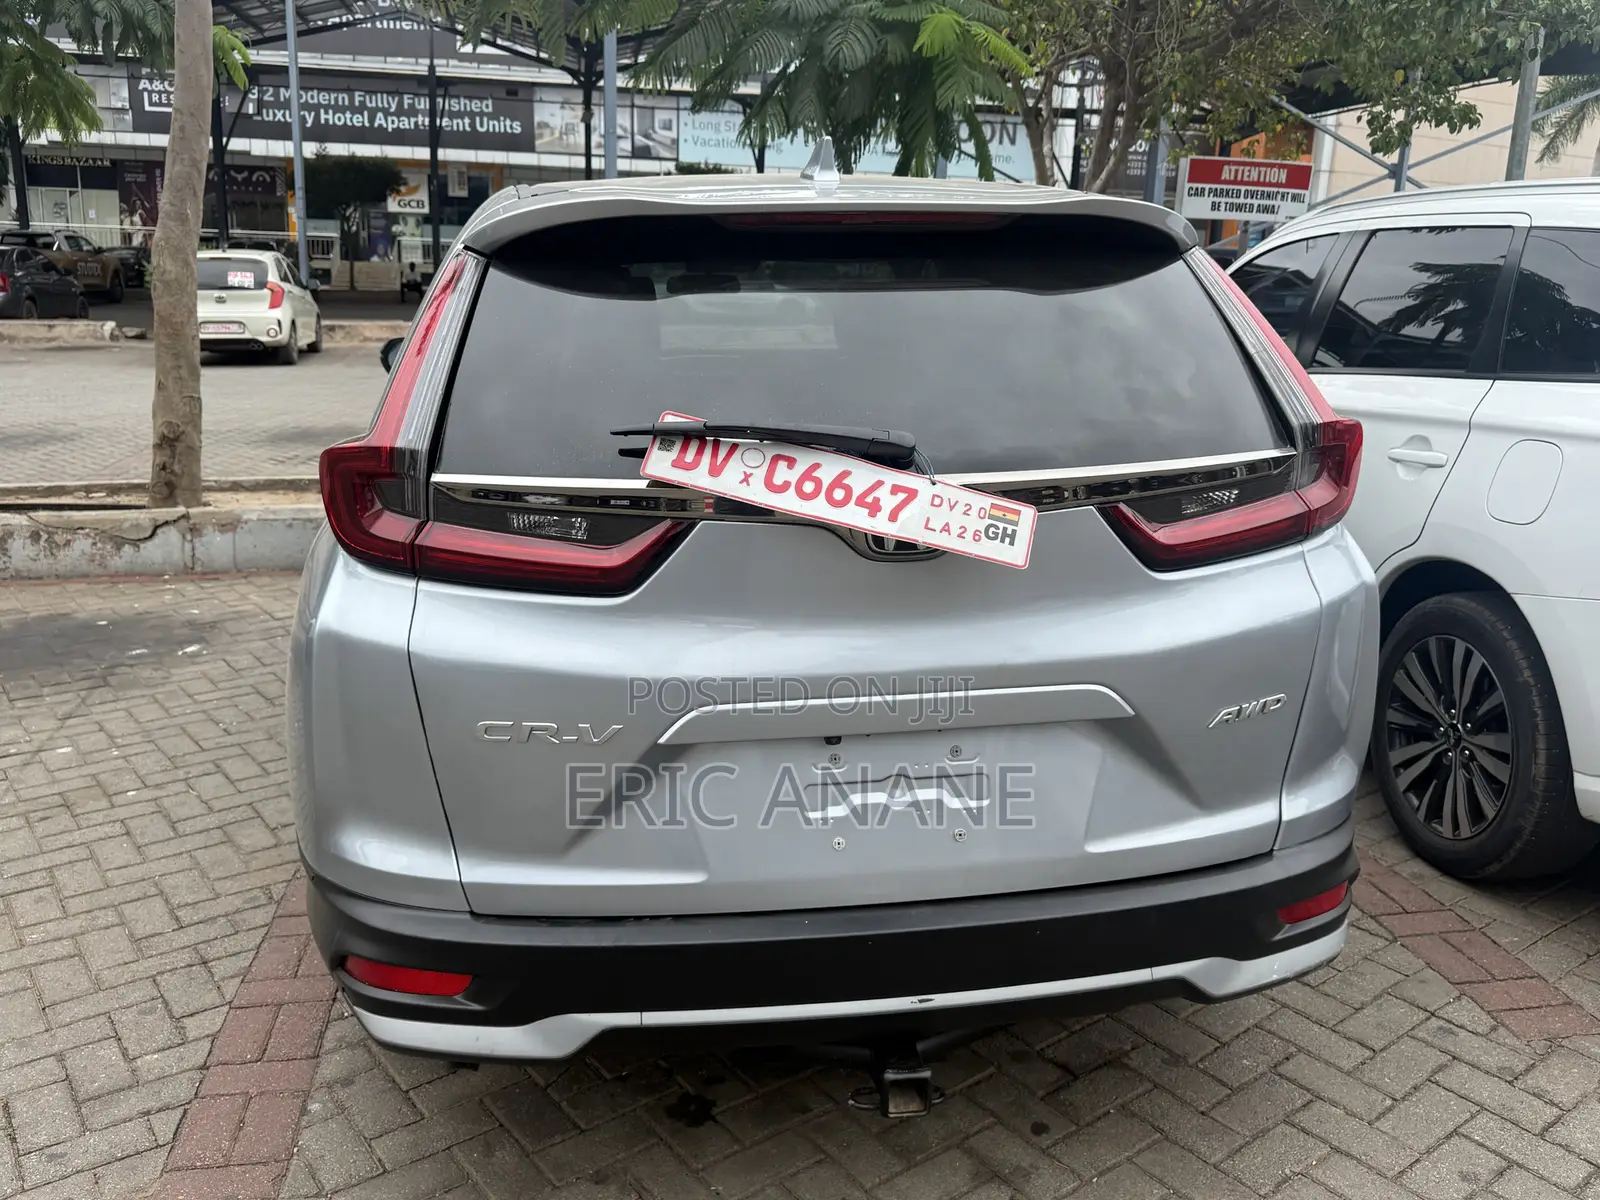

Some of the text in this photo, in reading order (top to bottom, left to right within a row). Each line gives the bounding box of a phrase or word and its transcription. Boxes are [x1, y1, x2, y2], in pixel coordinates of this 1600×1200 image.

[354, 91, 399, 112] Fully
[404, 94, 493, 113] Funished
[248, 102, 315, 128] Luxuy
[320, 108, 370, 127] Hotel
[475, 116, 522, 134] Units
[692, 119, 722, 134] Long
[692, 135, 746, 150] Vacatio
[1221, 165, 1288, 184] ATTENTION
[397, 199, 425, 209] GCB
[1187, 186, 1206, 198] CAR
[1207, 187, 1241, 199] PARKED
[1290, 192, 1306, 204] WILL
[1210, 201, 1222, 212] BE
[1223, 202, 1255, 213] TOWED
[670, 433, 740, 479] DV
[763, 453, 919, 523] C6647
[930, 493, 988, 521] DV20
[923, 516, 1018, 547] LA26 GH
[1207, 693, 1287, 728] AWD
[476, 720, 624, 745] CR-V
